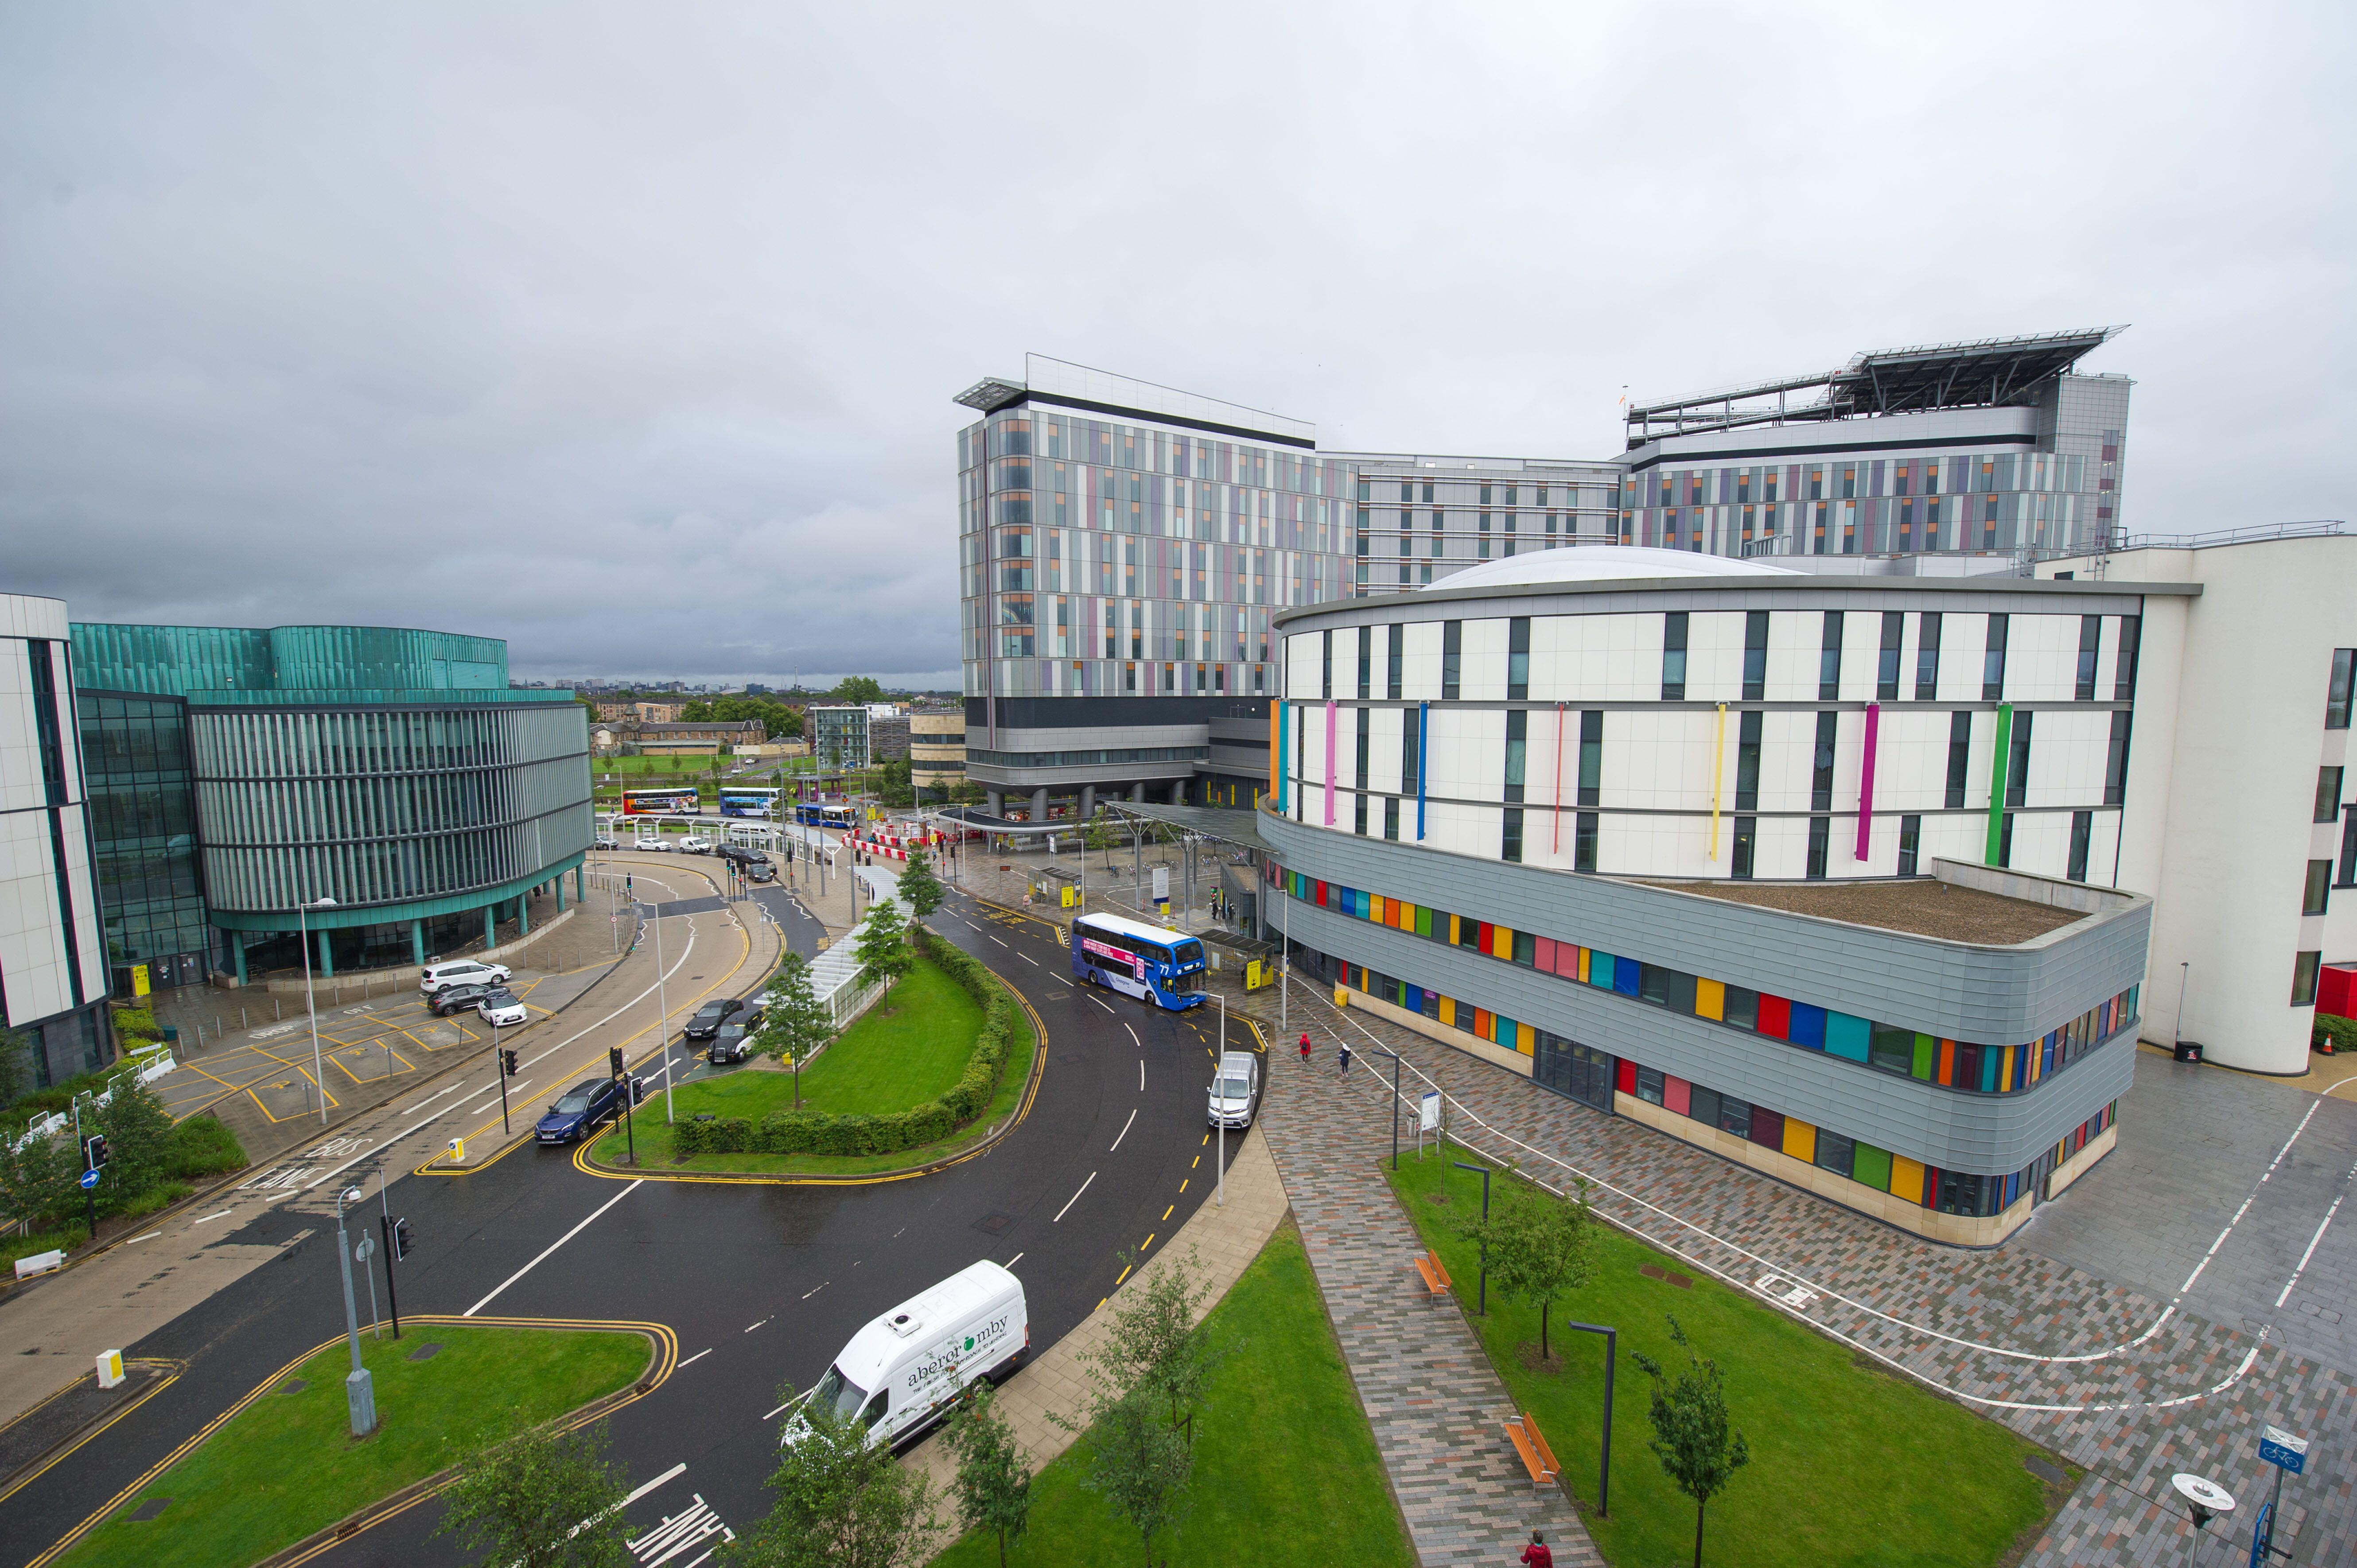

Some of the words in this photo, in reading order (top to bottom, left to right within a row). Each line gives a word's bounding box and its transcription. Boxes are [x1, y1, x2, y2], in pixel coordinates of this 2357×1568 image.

[1159, 965, 1169, 975] 77
[248, 1025, 295, 1039] DROP
[343, 1004, 373, 1015] OFF
[304, 1138, 373, 1158] BUS
[237, 1168, 326, 1190] LANE
